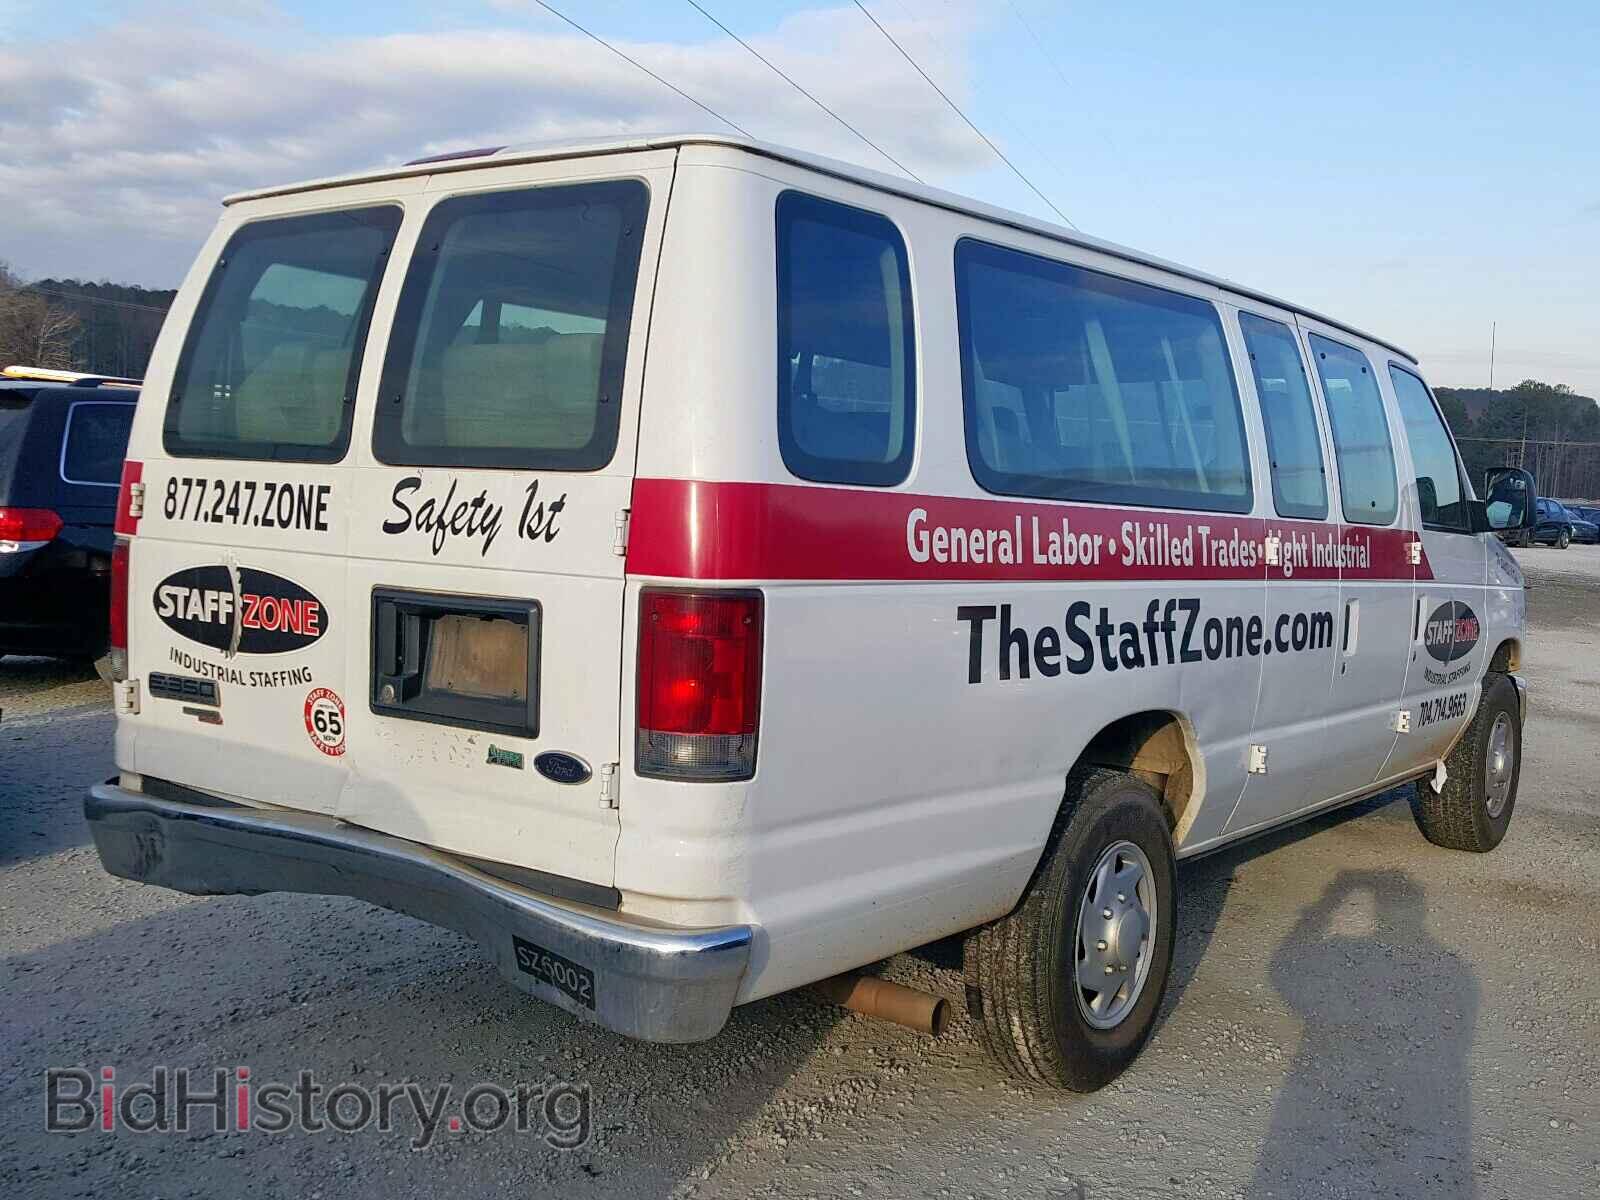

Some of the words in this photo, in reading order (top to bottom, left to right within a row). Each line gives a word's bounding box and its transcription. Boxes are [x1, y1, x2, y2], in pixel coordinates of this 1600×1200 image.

[164, 476, 331, 531] 877.247.ZONE
[382, 476, 504, 556] Safety
[517, 479, 568, 543] 1st
[906, 508, 1022, 565] General
[1032, 516, 1103, 566] Labor
[1122, 520, 1194, 568] Skilled
[1198, 525, 1257, 568] Trades
[1268, 529, 1308, 578] ight
[1312, 532, 1370, 569] Industrial
[158, 584, 234, 625] STAFF
[242, 593, 320, 636] ZONE
[1426, 620, 1453, 646] STAFF
[169, 646, 247, 686] INDUSTRIAL
[249, 666, 313, 688] STAFFING
[956, 597, 1333, 685] TheStaffZone.com
[314, 709, 341, 735] 65
[517, 946, 592, 1000] SZ6002
